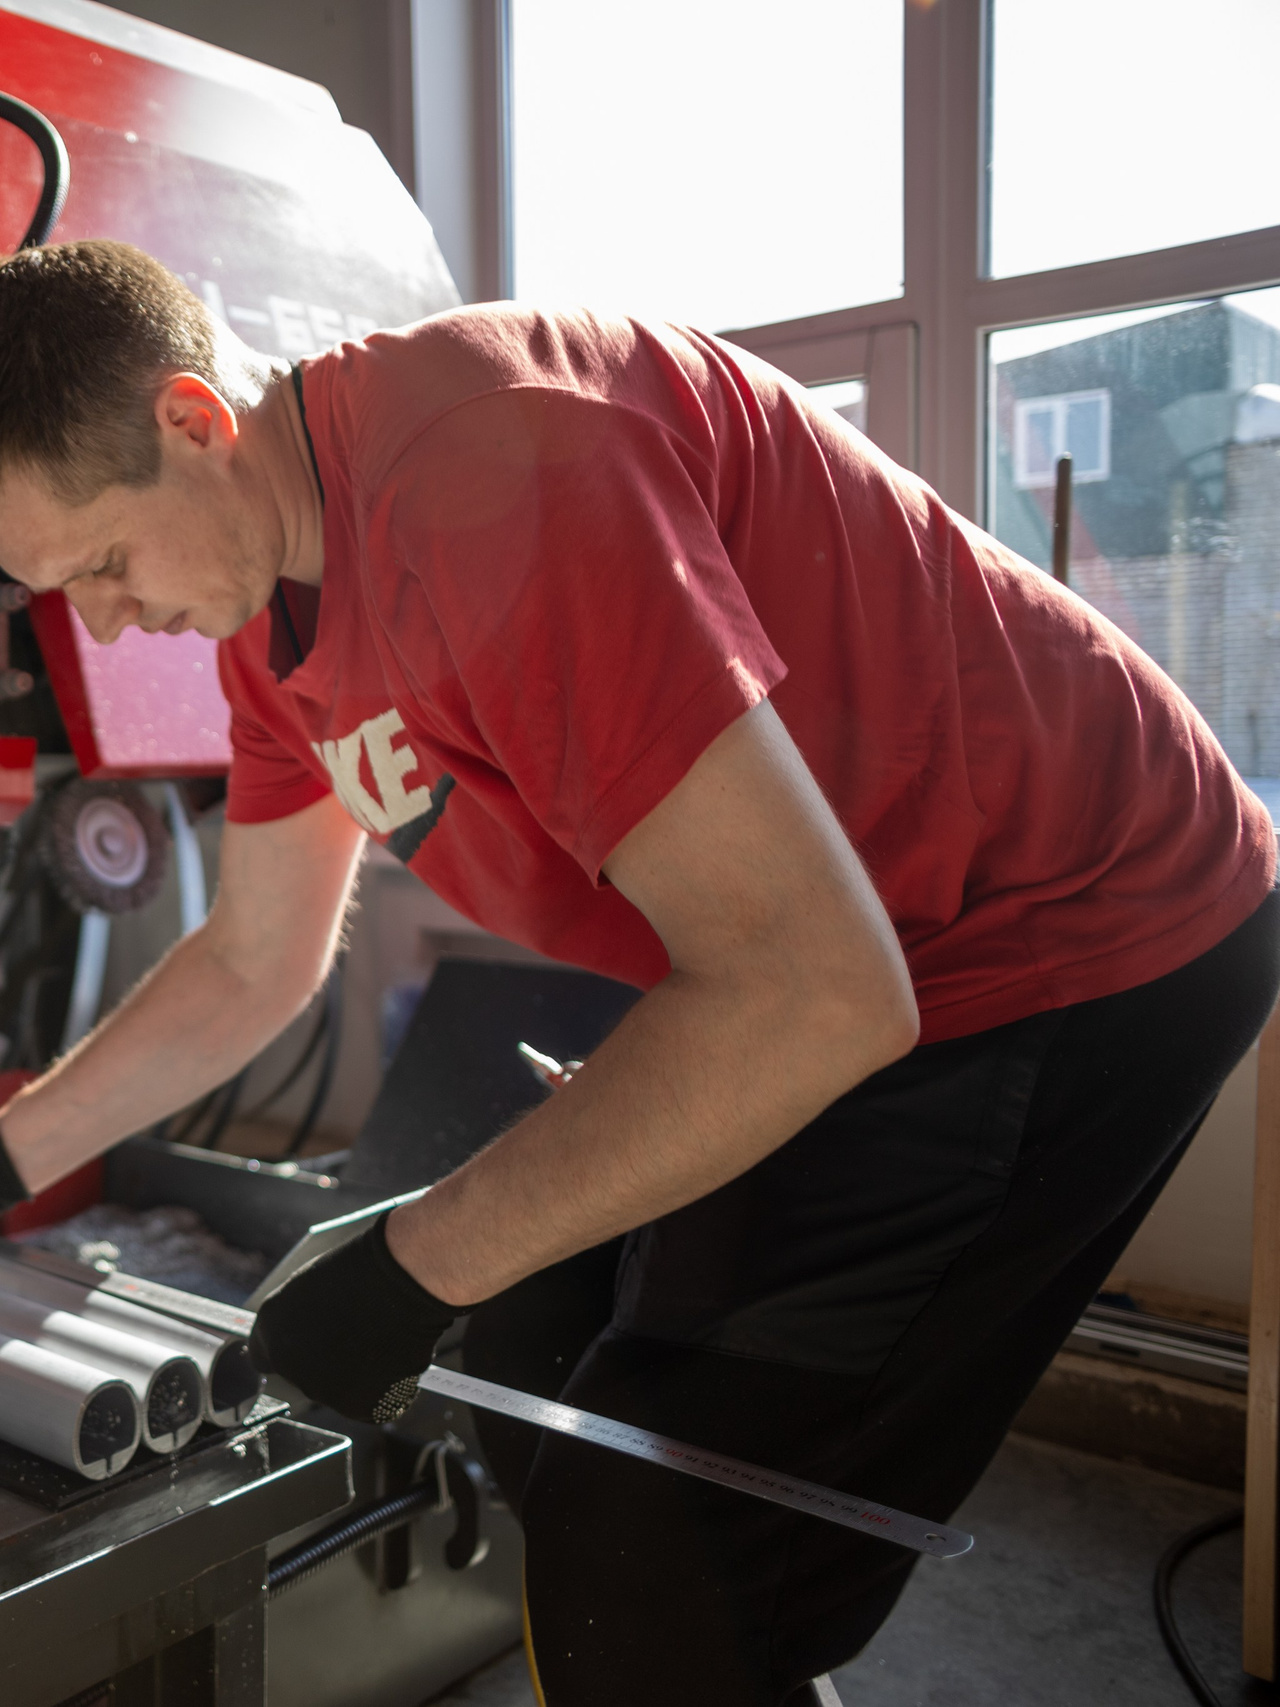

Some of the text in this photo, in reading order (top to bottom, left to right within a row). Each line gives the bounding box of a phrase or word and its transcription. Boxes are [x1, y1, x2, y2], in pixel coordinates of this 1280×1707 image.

[310, 707, 433, 834] KE
[647, 1443, 663, 1451] 89
[665, 1448, 683, 1458] 90
[685, 1454, 699, 1463] 91
[703, 1460, 719, 1469] 92
[741, 1472, 756, 1481] 94
[760, 1478, 776, 1487] 95
[800, 1491, 817, 1500] 97
[860, 1511, 891, 1525] 100
